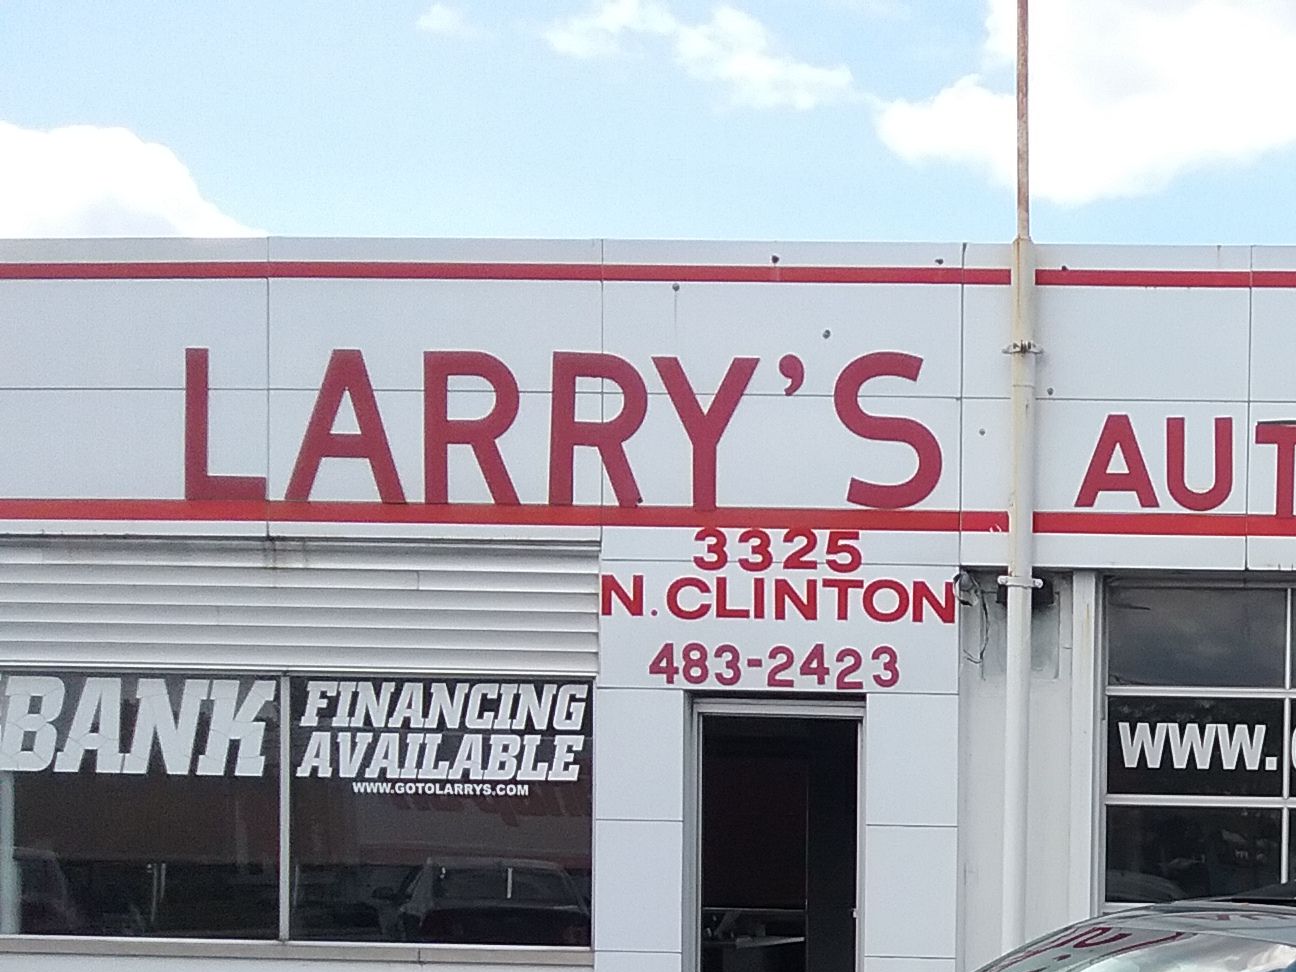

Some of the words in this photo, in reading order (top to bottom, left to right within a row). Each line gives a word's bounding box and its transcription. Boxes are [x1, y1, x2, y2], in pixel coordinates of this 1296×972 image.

[184, 347, 943, 511] LARRY'S
[692, 527, 863, 574] 3325
[648, 643, 901, 691] 483-2423
[0, 675, 277, 777] BANK
[298, 679, 589, 732] FINANCING
[296, 731, 585, 783] AVAILABLE
[352, 781, 530, 797] WWW.GOTOLARRYS.COM
